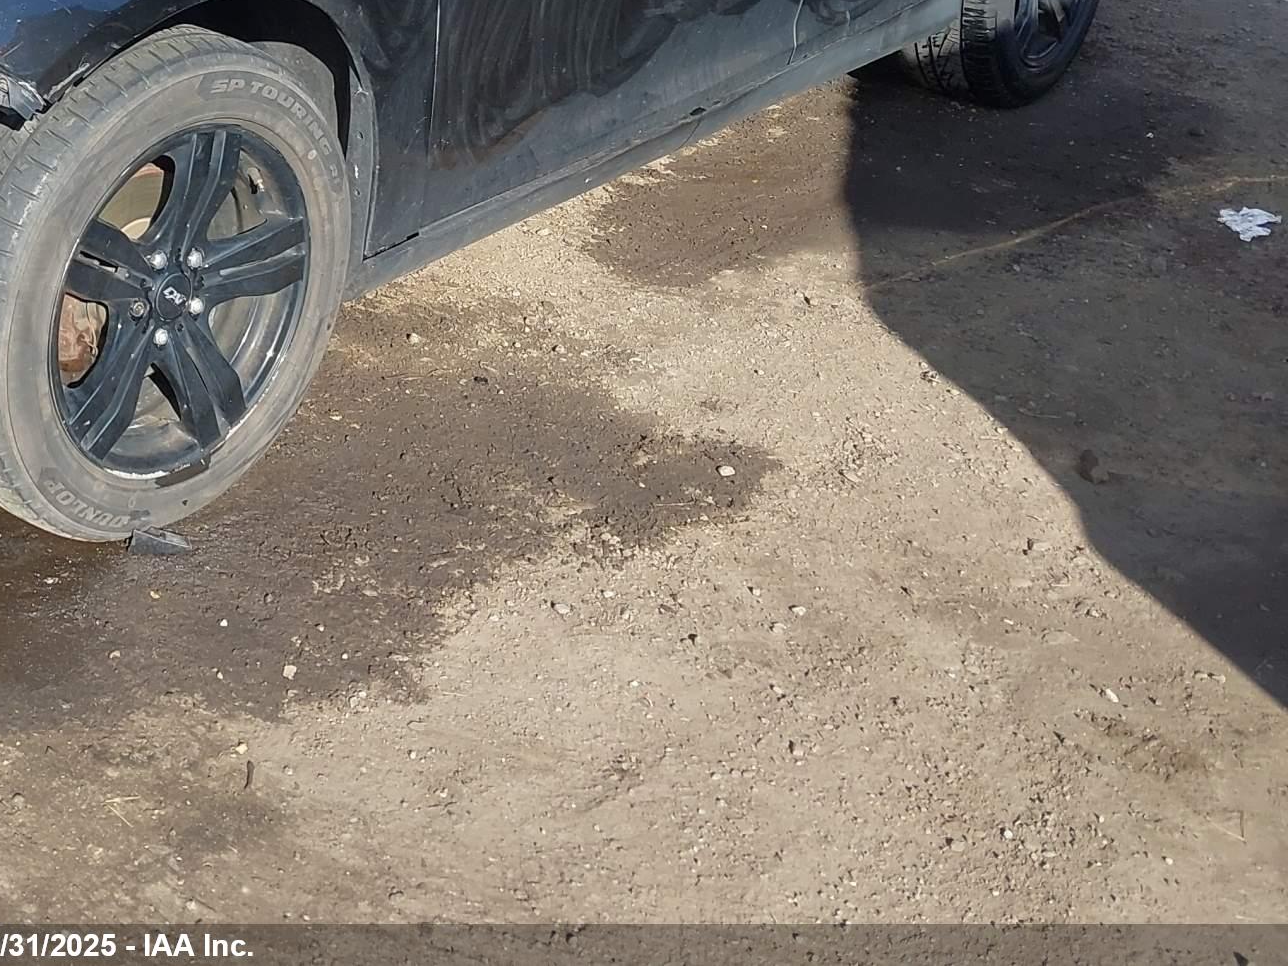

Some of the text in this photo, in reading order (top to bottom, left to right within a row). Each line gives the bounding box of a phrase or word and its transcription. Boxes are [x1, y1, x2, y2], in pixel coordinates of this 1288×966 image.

[210, 79, 333, 156] SP TOURING
[43, 480, 131, 529] DUNLOP
